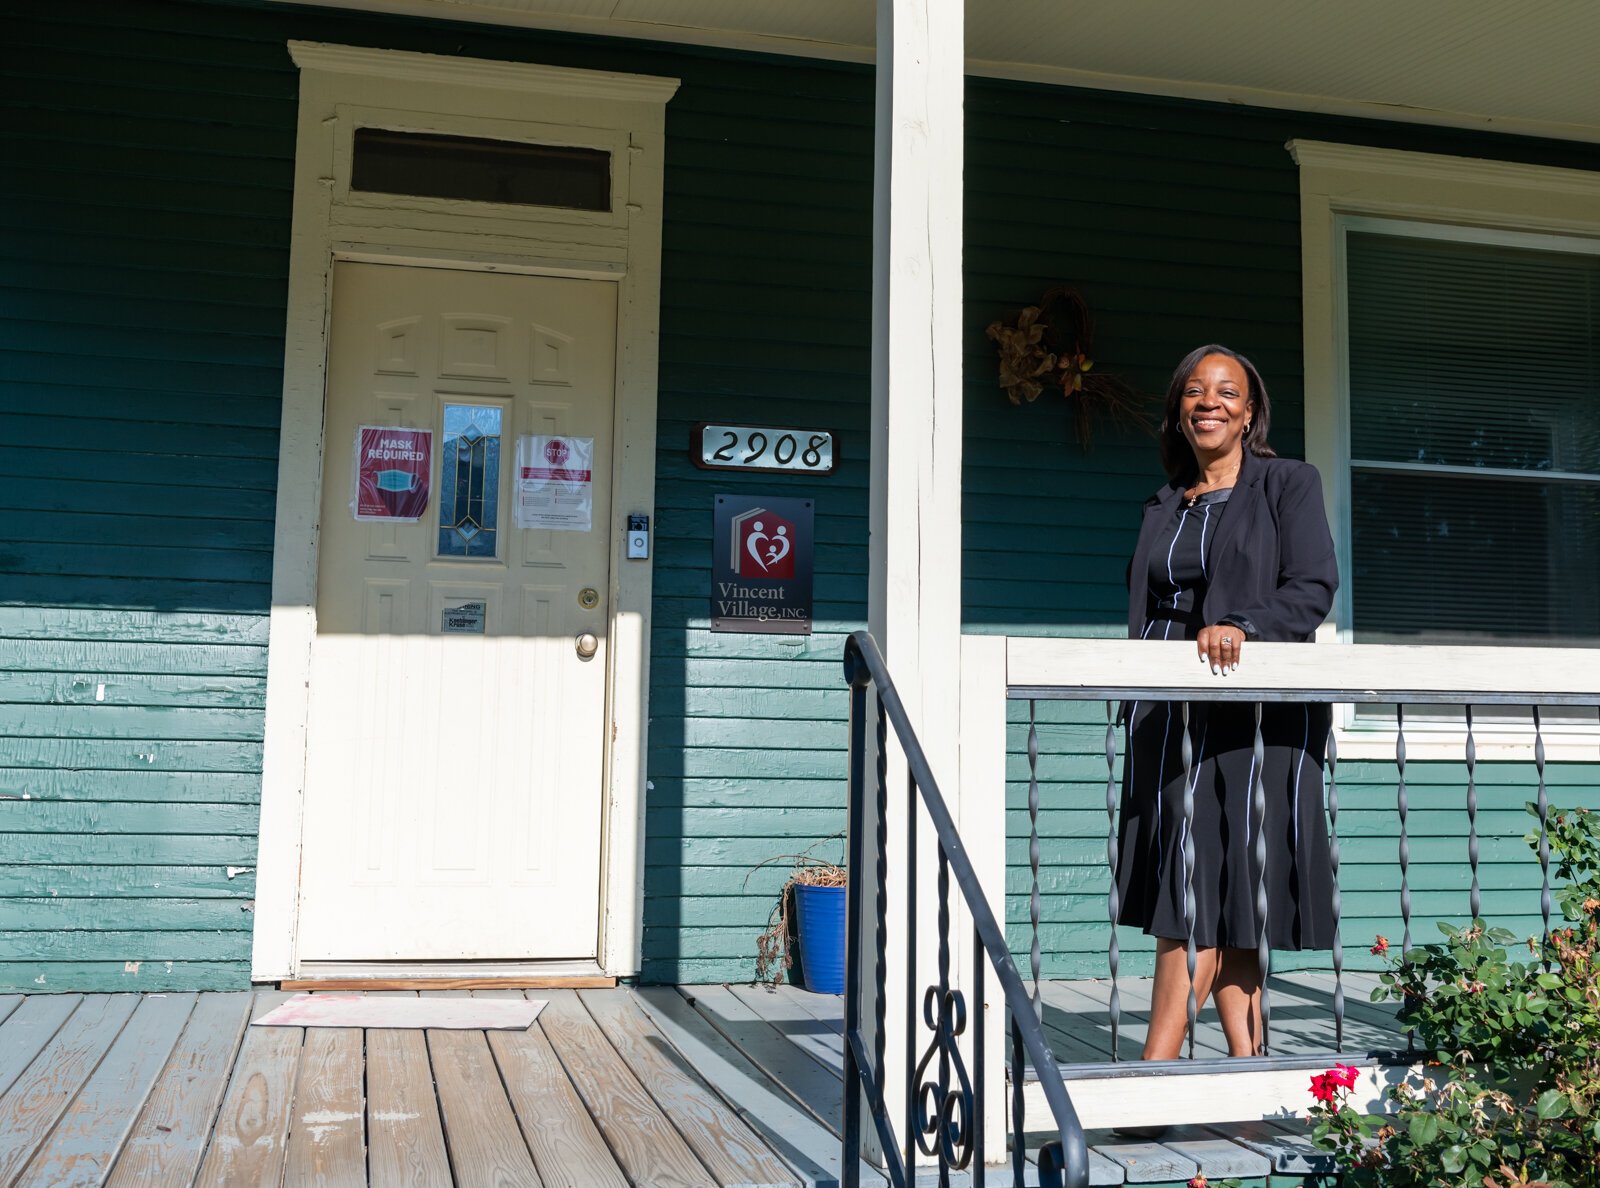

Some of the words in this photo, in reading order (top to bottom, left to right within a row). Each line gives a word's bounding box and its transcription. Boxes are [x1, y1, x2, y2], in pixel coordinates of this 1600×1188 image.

[380, 438, 413, 450] MASK
[713, 431, 828, 467] 2908
[368, 449, 424, 461] REQUIRED
[546, 448, 568, 457] STOP
[718, 582, 785, 600] Vincent
